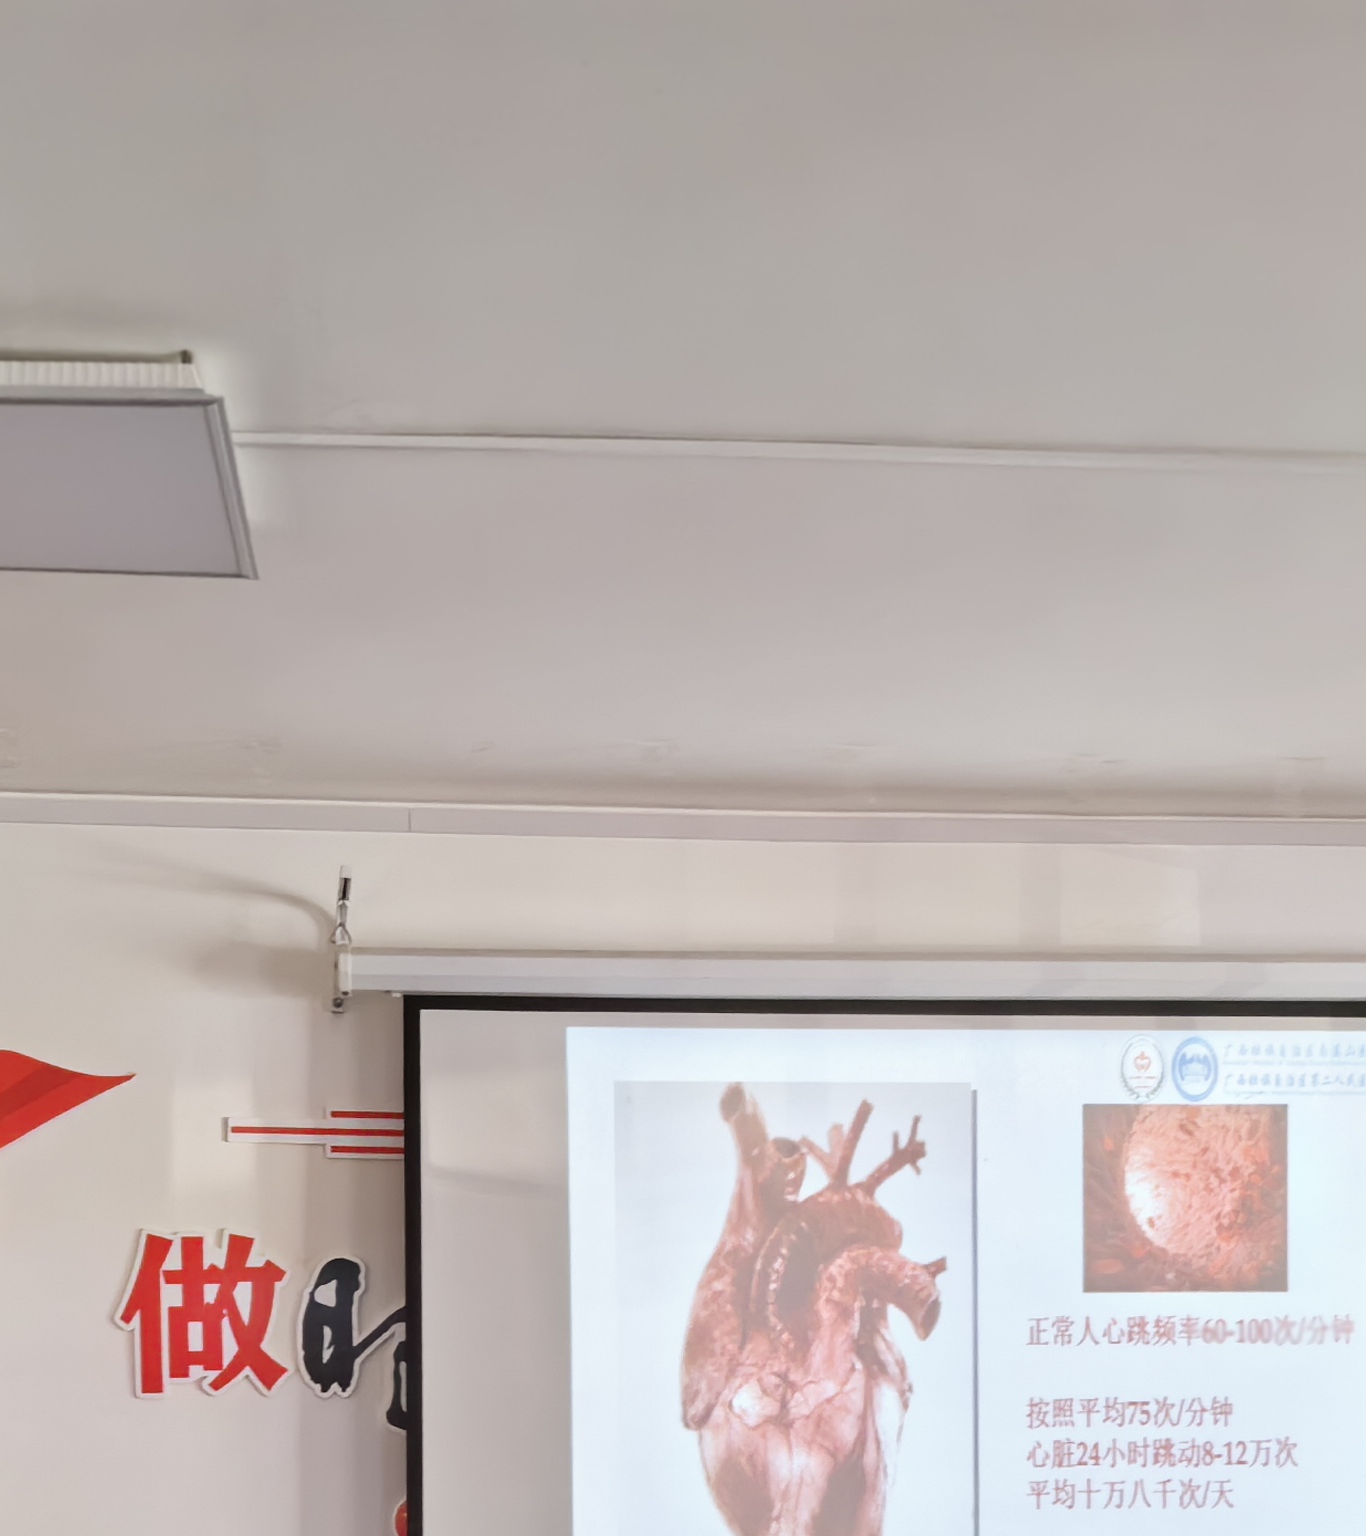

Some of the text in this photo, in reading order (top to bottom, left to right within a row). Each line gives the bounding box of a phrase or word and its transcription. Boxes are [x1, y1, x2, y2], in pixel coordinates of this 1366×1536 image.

[1026, 1315, 1356, 1346] 正常人心跳频率60-100次/分钟
[1026, 1396, 1234, 1429] 按照平均75次/分钟
[1027, 1436, 1299, 1469] 心脏24小时跳动8-12万次
[1026, 1478, 1235, 1510] 平均十万八千次/天
